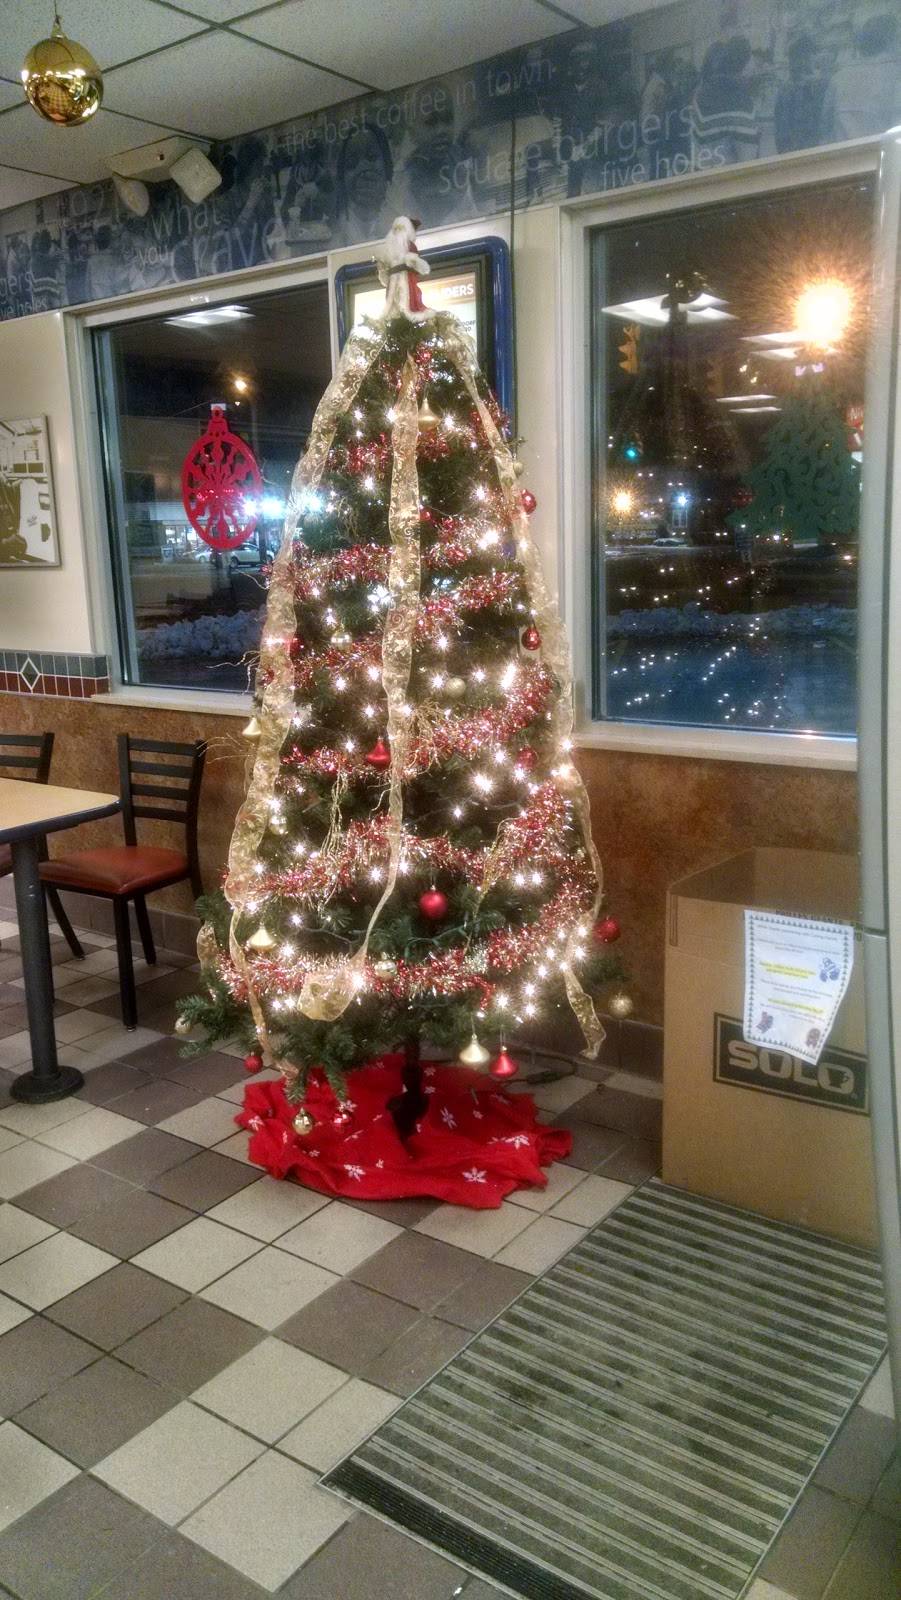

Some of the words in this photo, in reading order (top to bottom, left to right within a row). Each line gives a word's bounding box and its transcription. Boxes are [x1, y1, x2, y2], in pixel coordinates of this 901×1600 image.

[285, 125, 316, 154] the
[323, 108, 369, 144] best
[376, 86, 446, 128] coffee
[456, 80, 476, 105] in
[553, 104, 696, 165] burgers
[602, 159, 646, 191] five
[654, 143, 726, 179] holes
[150, 198, 224, 240] what
[170, 217, 288, 282] crave
[727, 1039, 855, 1095] SOLO
